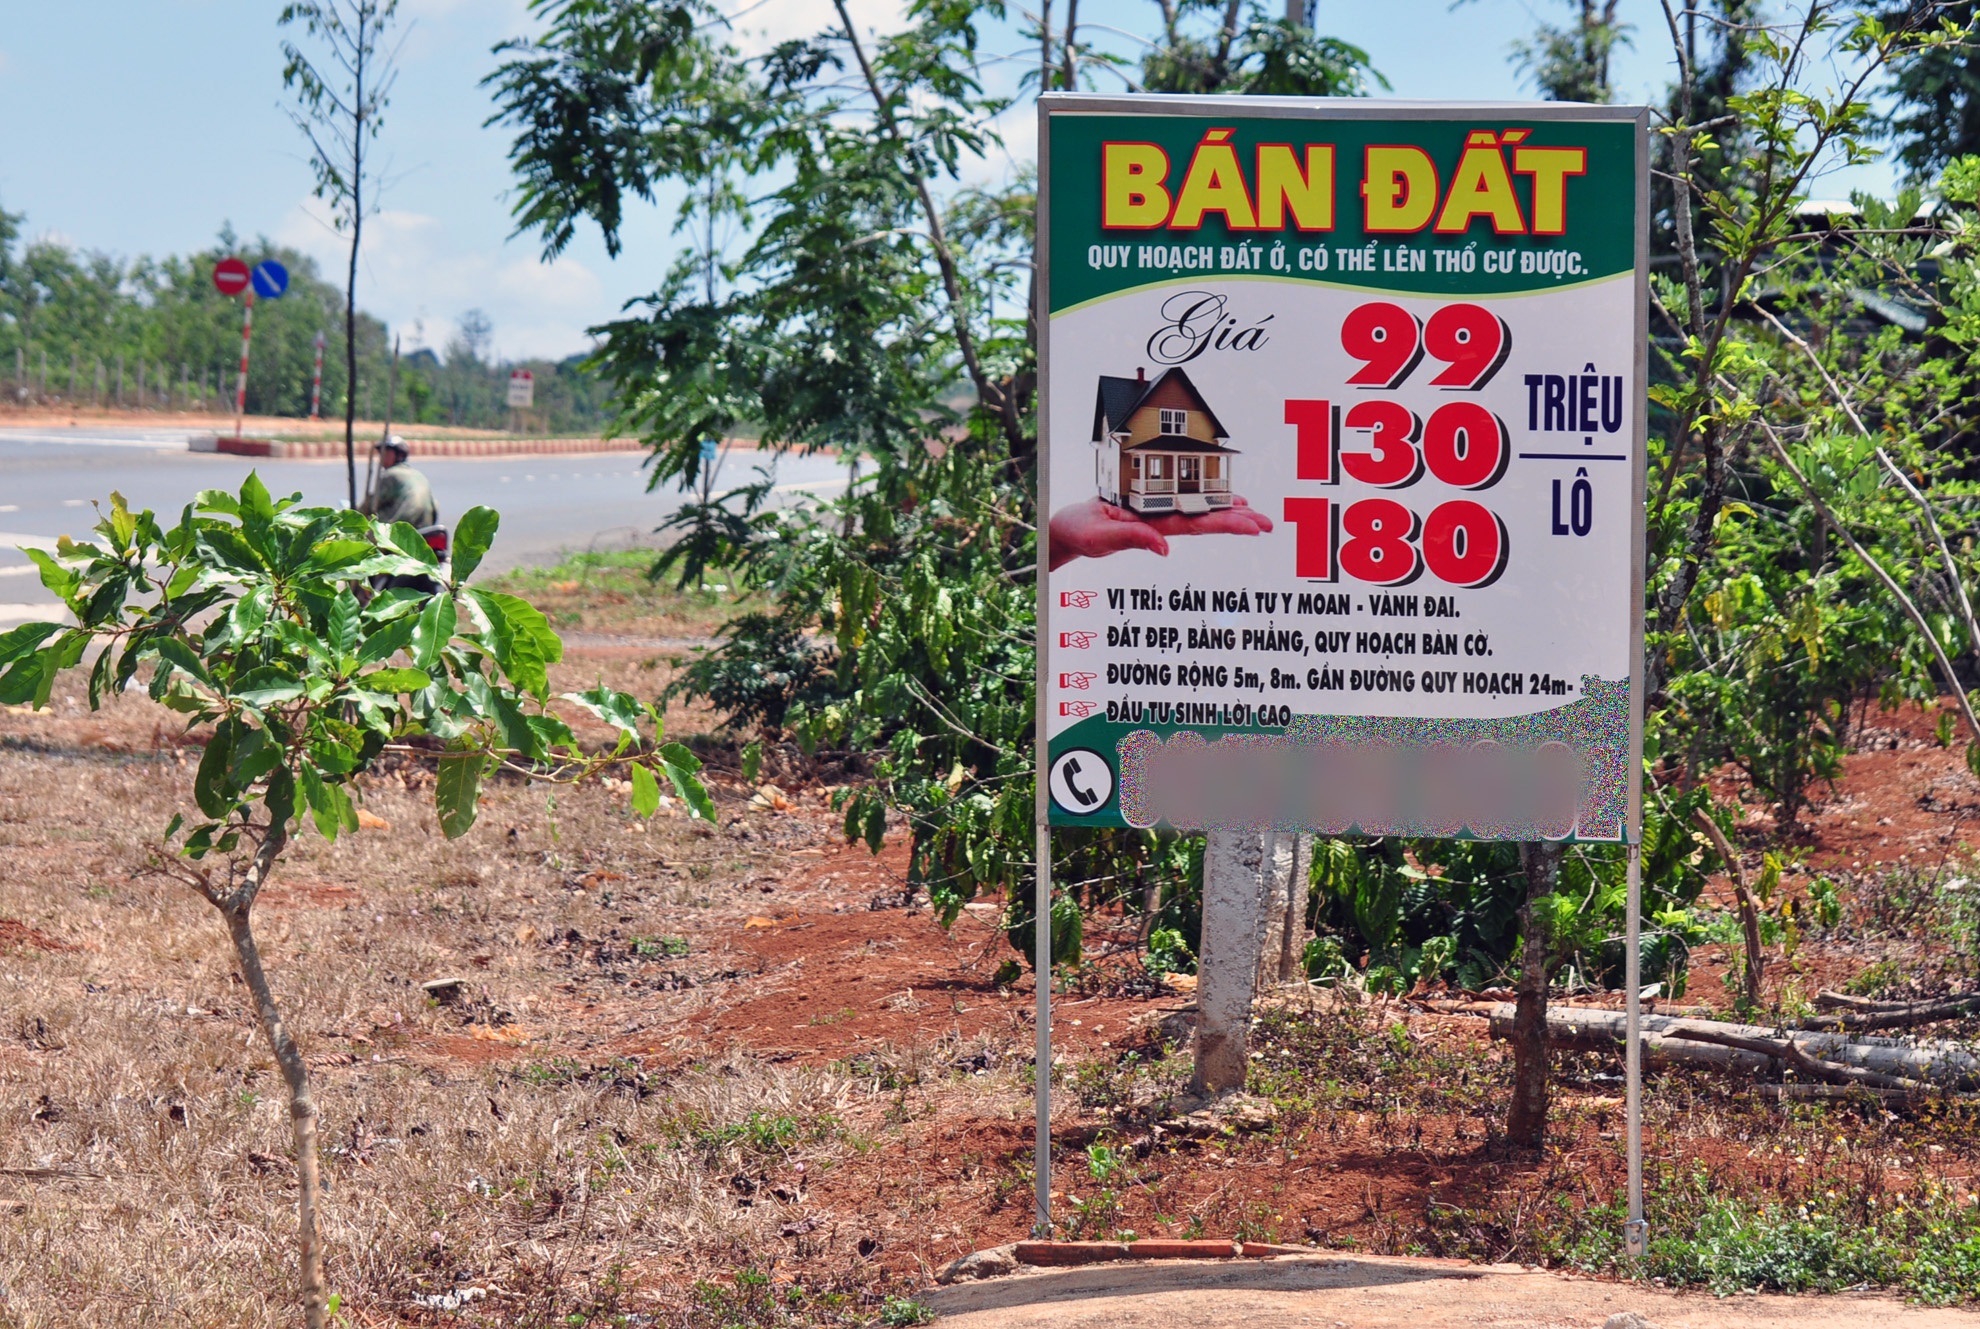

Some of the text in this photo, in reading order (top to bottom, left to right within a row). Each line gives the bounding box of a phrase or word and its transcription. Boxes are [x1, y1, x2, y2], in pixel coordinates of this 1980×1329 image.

[1102, 127, 1587, 235] BÁN ĐẤT
[1088, 239, 1588, 279] QUY HOẠCH ĐẤT Ở, CÓ THỂ LÊN THỔ CƯ ĐƯỢC.
[1147, 290, 1275, 365] Giá
[1340, 301, 1512, 391] 99
[1524, 363, 1623, 445] TRIỆU
[1284, 399, 1510, 491] 130
[1551, 467, 1593, 537] LÔ
[1283, 497, 1509, 589] 180
[1107, 588, 1124, 615] VỊ
[1130, 584, 1163, 611] TRÍ:
[1168, 583, 1206, 612] GẦN
[1255, 592, 1278, 614] TƯ
[1281, 593, 1293, 614] Y
[1297, 593, 1350, 616] MOAN
[1369, 591, 1418, 617] VÀNH
[1424, 595, 1460, 618] ĐAI.
[1107, 619, 1493, 660] ĐẤT ĐẸP, BẰNG PHẲNG, QUY HOẠCH BÀN CỜ.
[1106, 694, 1291, 727] ĐẦU TƯ SINH LỜI CAO
[1107, 658, 1172, 686] ĐƯỜNG
[1177, 661, 1228, 692] RỘNG
[1233, 666, 1265, 693] 5m,
[1270, 667, 1301, 690] 8m.
[1307, 661, 1344, 691] GẦN
[1350, 664, 1415, 692] ĐƯỜNG
[1421, 671, 1458, 694] QUY
[1463, 671, 1523, 700] HOẠCH
